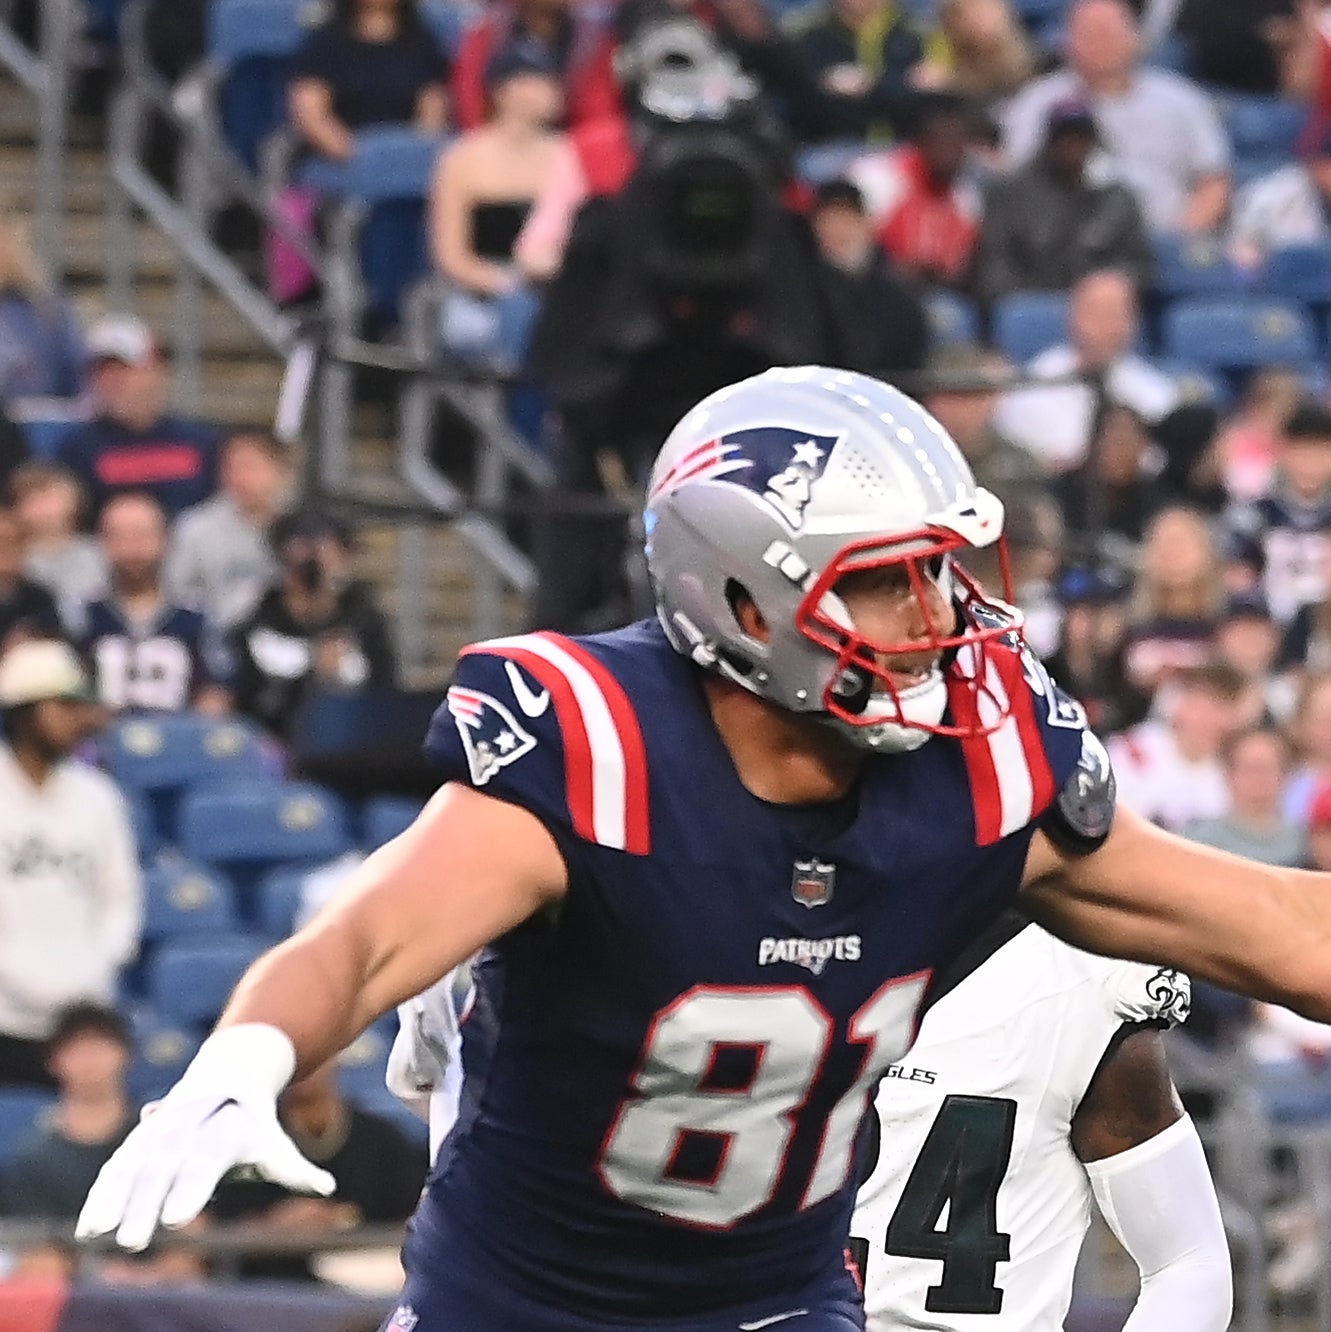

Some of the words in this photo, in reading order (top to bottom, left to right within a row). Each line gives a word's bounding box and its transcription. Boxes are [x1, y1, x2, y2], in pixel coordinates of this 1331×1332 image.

[758, 935, 862, 966] PATRIOTS
[594, 969, 934, 1231] 81
[886, 1064, 938, 1085] GLES
[849, 1094, 1018, 1315] 4
